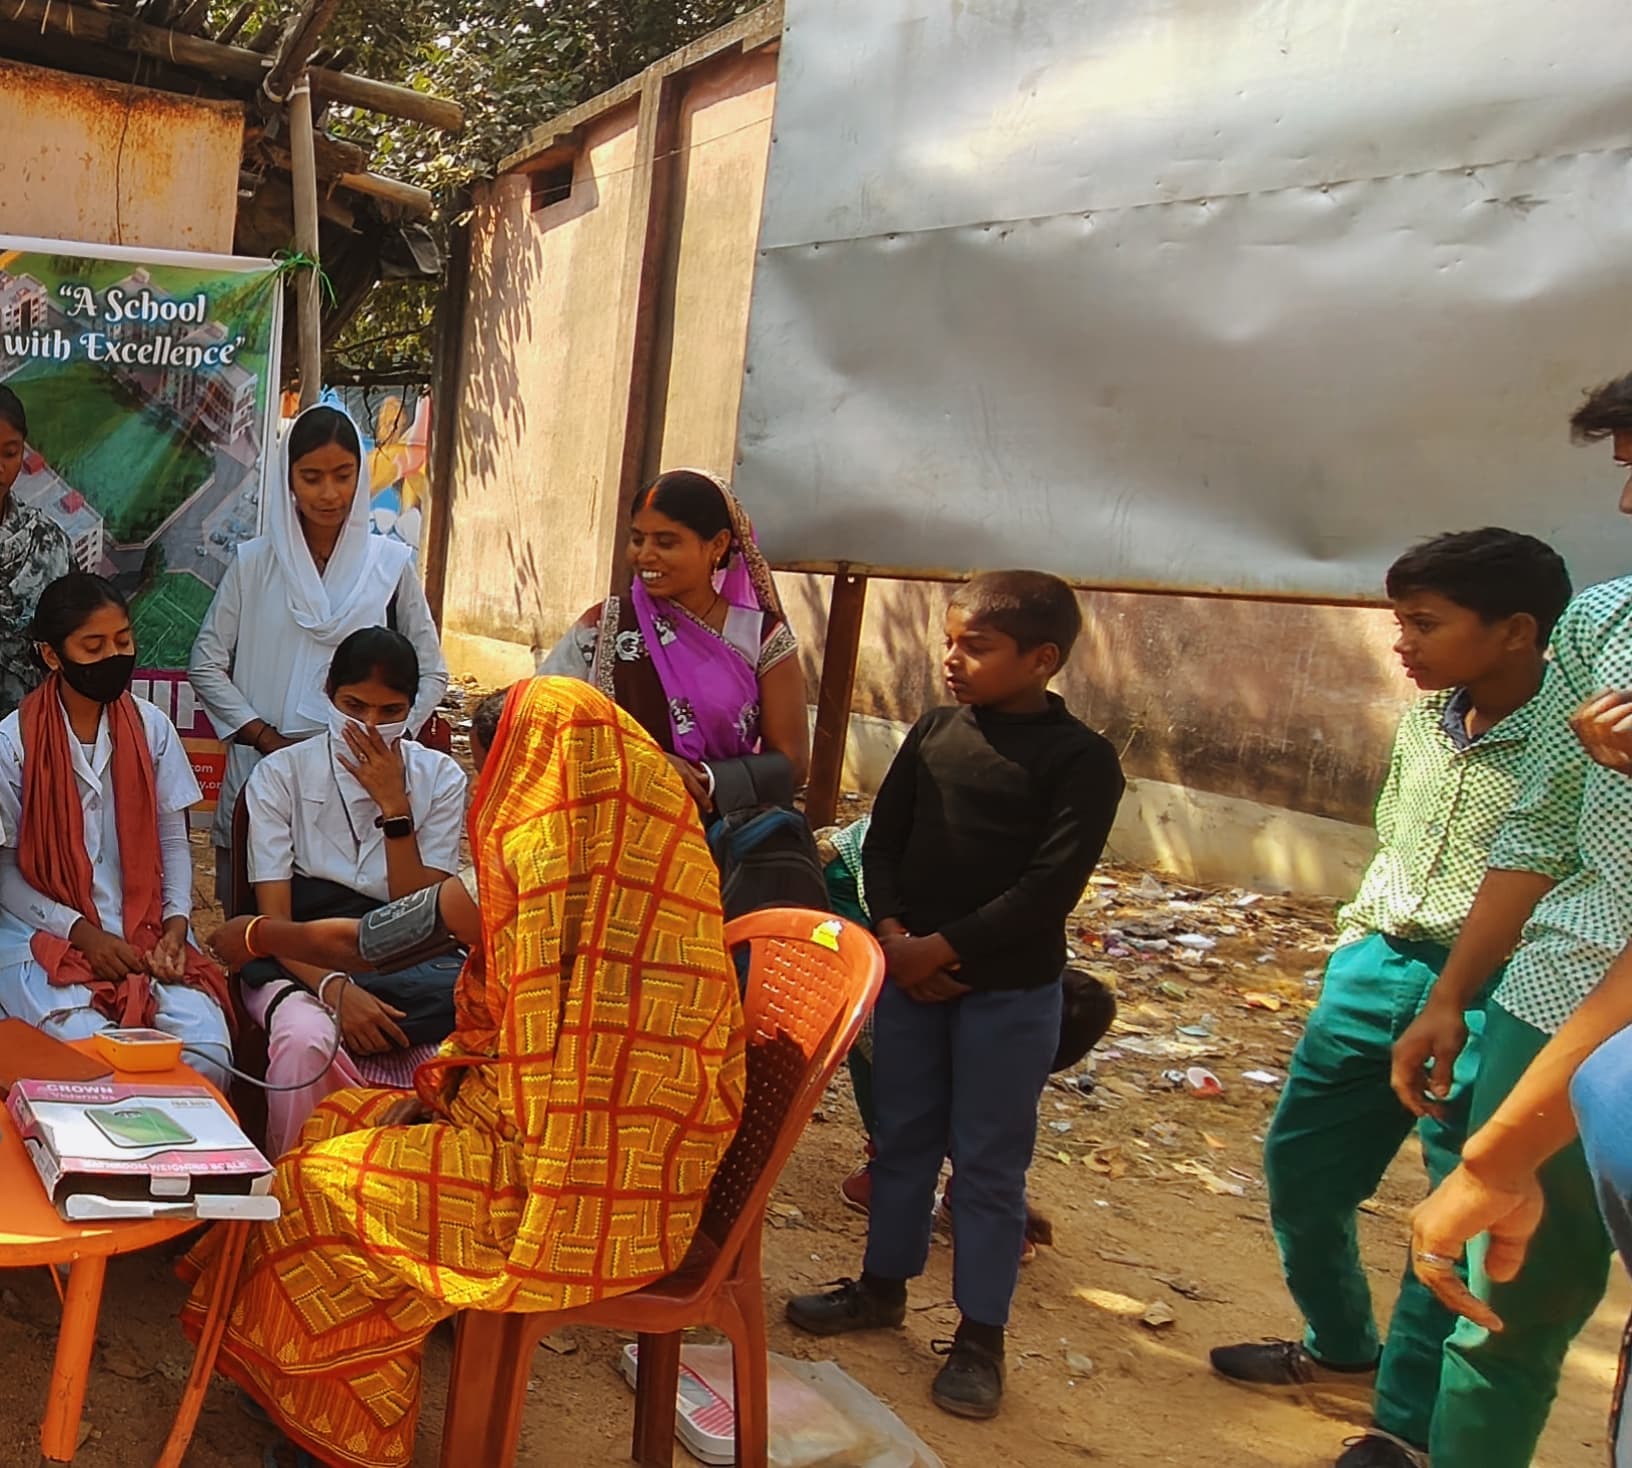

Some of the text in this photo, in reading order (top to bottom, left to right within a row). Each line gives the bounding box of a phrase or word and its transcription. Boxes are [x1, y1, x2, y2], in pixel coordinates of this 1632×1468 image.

[104, 288, 206, 324] School
[4, 329, 71, 361] with
[46, 1083, 113, 1094] CROWN
